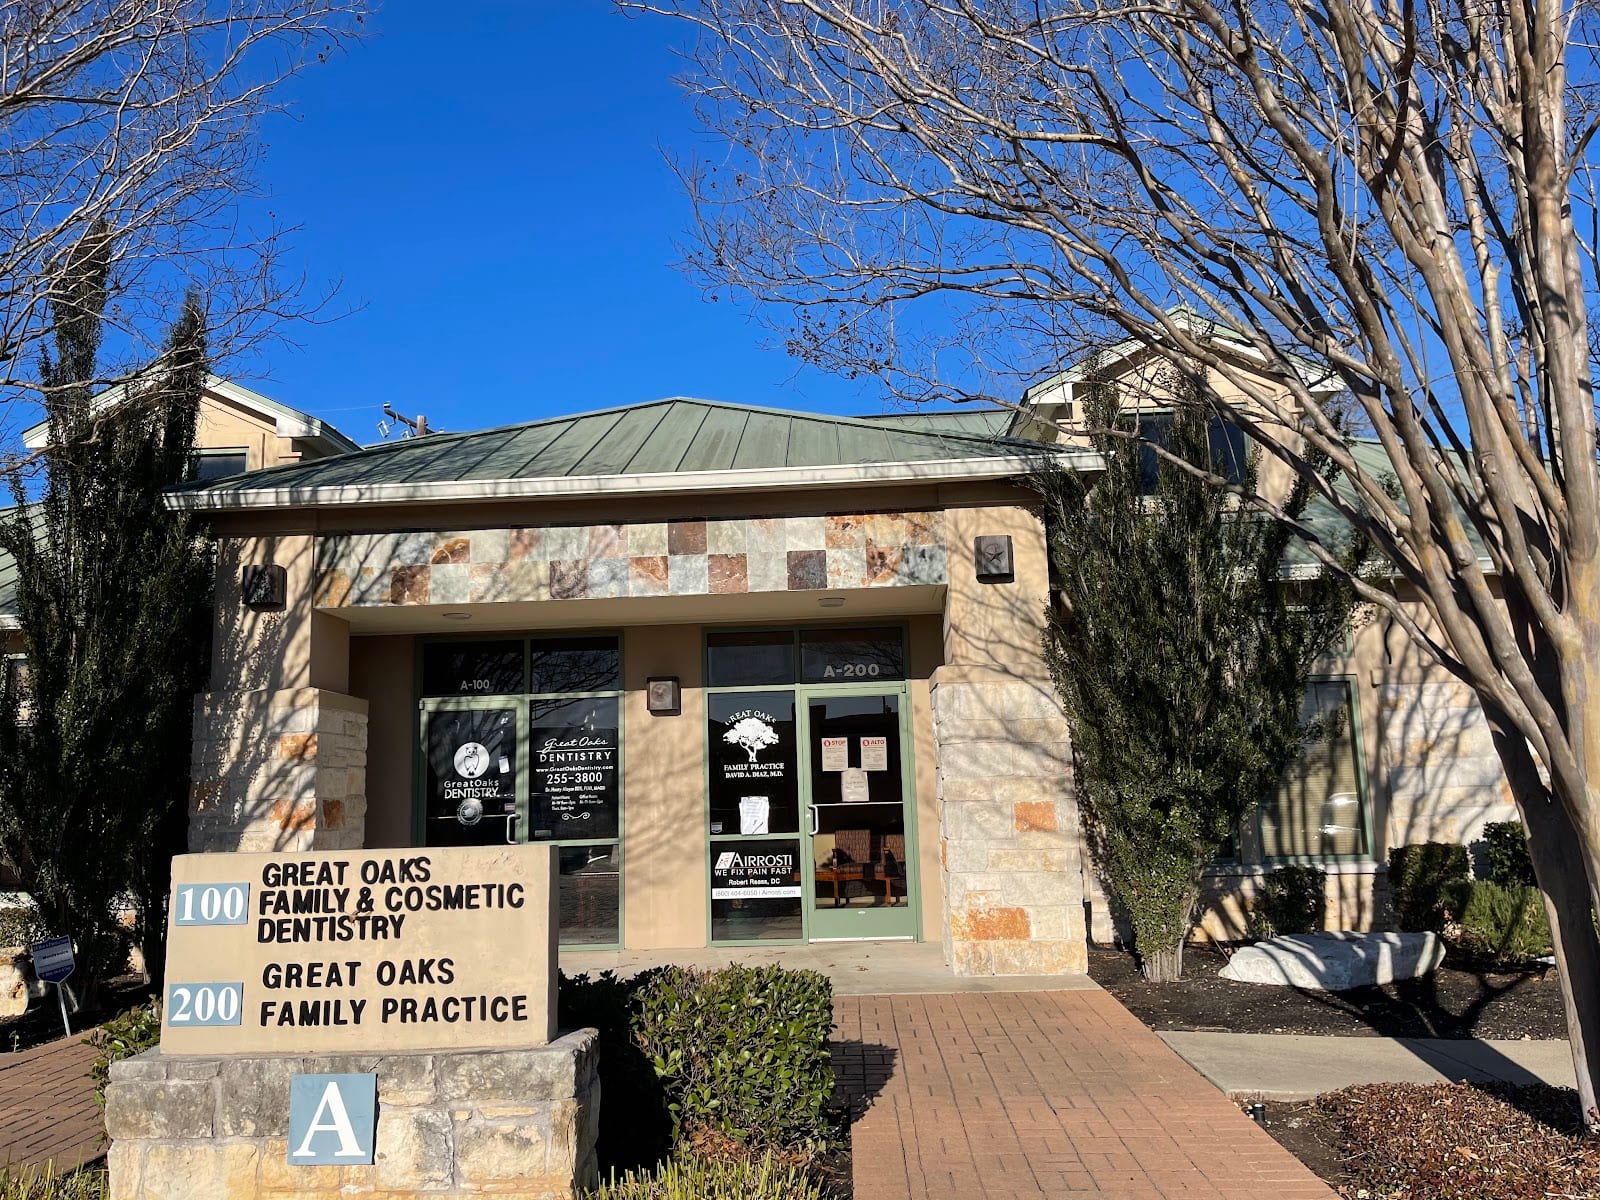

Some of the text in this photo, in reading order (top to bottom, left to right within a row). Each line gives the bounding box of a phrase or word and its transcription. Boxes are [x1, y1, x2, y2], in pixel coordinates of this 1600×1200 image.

[823, 663, 880, 678] A-200
[460, 679, 490, 690] A-100
[542, 736, 609, 753] Great Oaks
[540, 752, 611, 762] DENTISTRY
[750, 762, 785, 770] PRACTICE
[546, 771, 603, 784] 255-3800
[444, 786, 500, 799] DENTISTRY
[262, 856, 431, 888] GREAT OAKS
[730, 868, 745, 876] FIX
[178, 886, 245, 921] 100
[259, 883, 525, 915] FAMILY & COSMETIC
[257, 914, 406, 944] DENTISTRY
[262, 958, 455, 989] GREAT OAKS
[170, 986, 239, 1022] 200
[260, 995, 529, 1027] FAMILY PRACTICE
[292, 1081, 366, 1157] A
